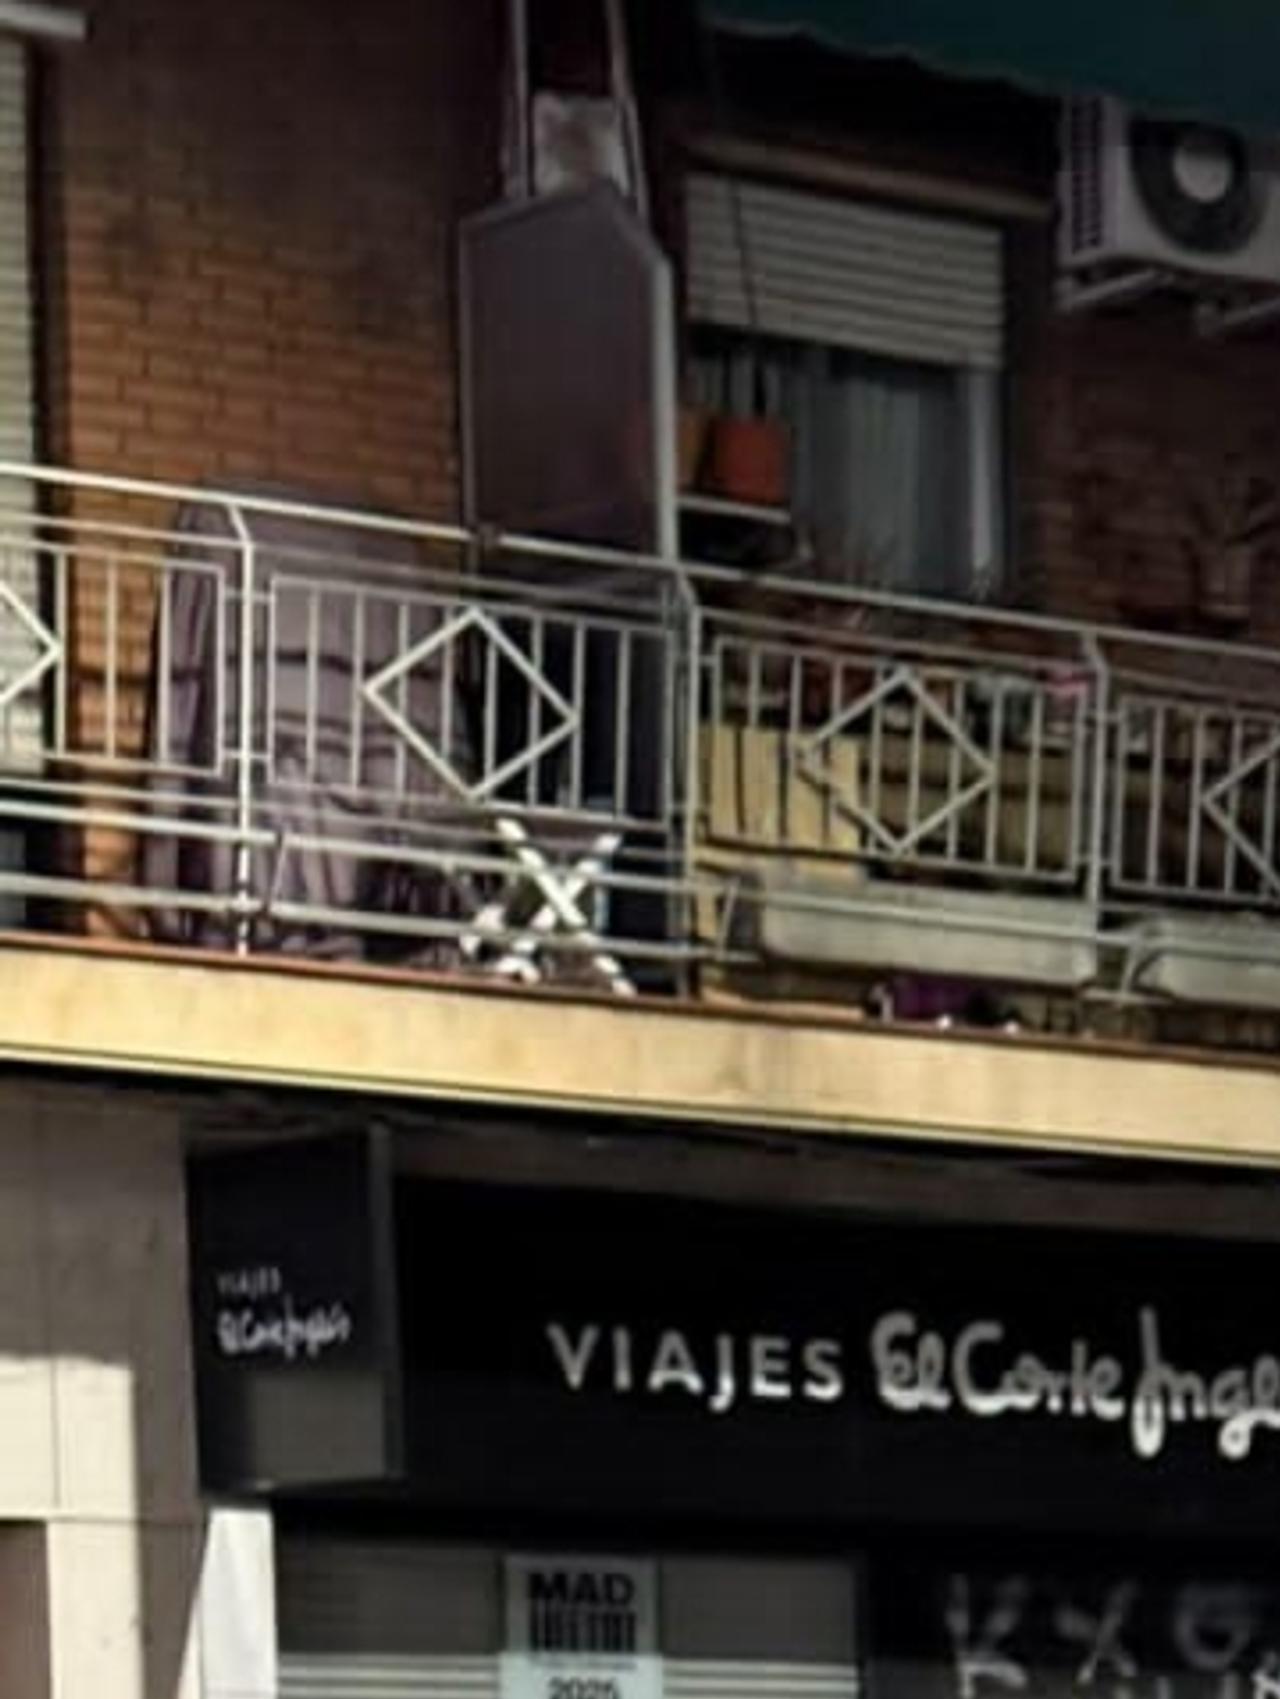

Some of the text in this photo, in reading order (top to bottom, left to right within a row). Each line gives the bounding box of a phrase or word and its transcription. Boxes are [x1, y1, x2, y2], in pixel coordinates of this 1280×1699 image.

[547, 1322, 844, 1411] VIAJES
[871, 1309, 952, 1411] El
[951, 1320, 1126, 1420] Corte
[527, 1570, 637, 1606] MAD
